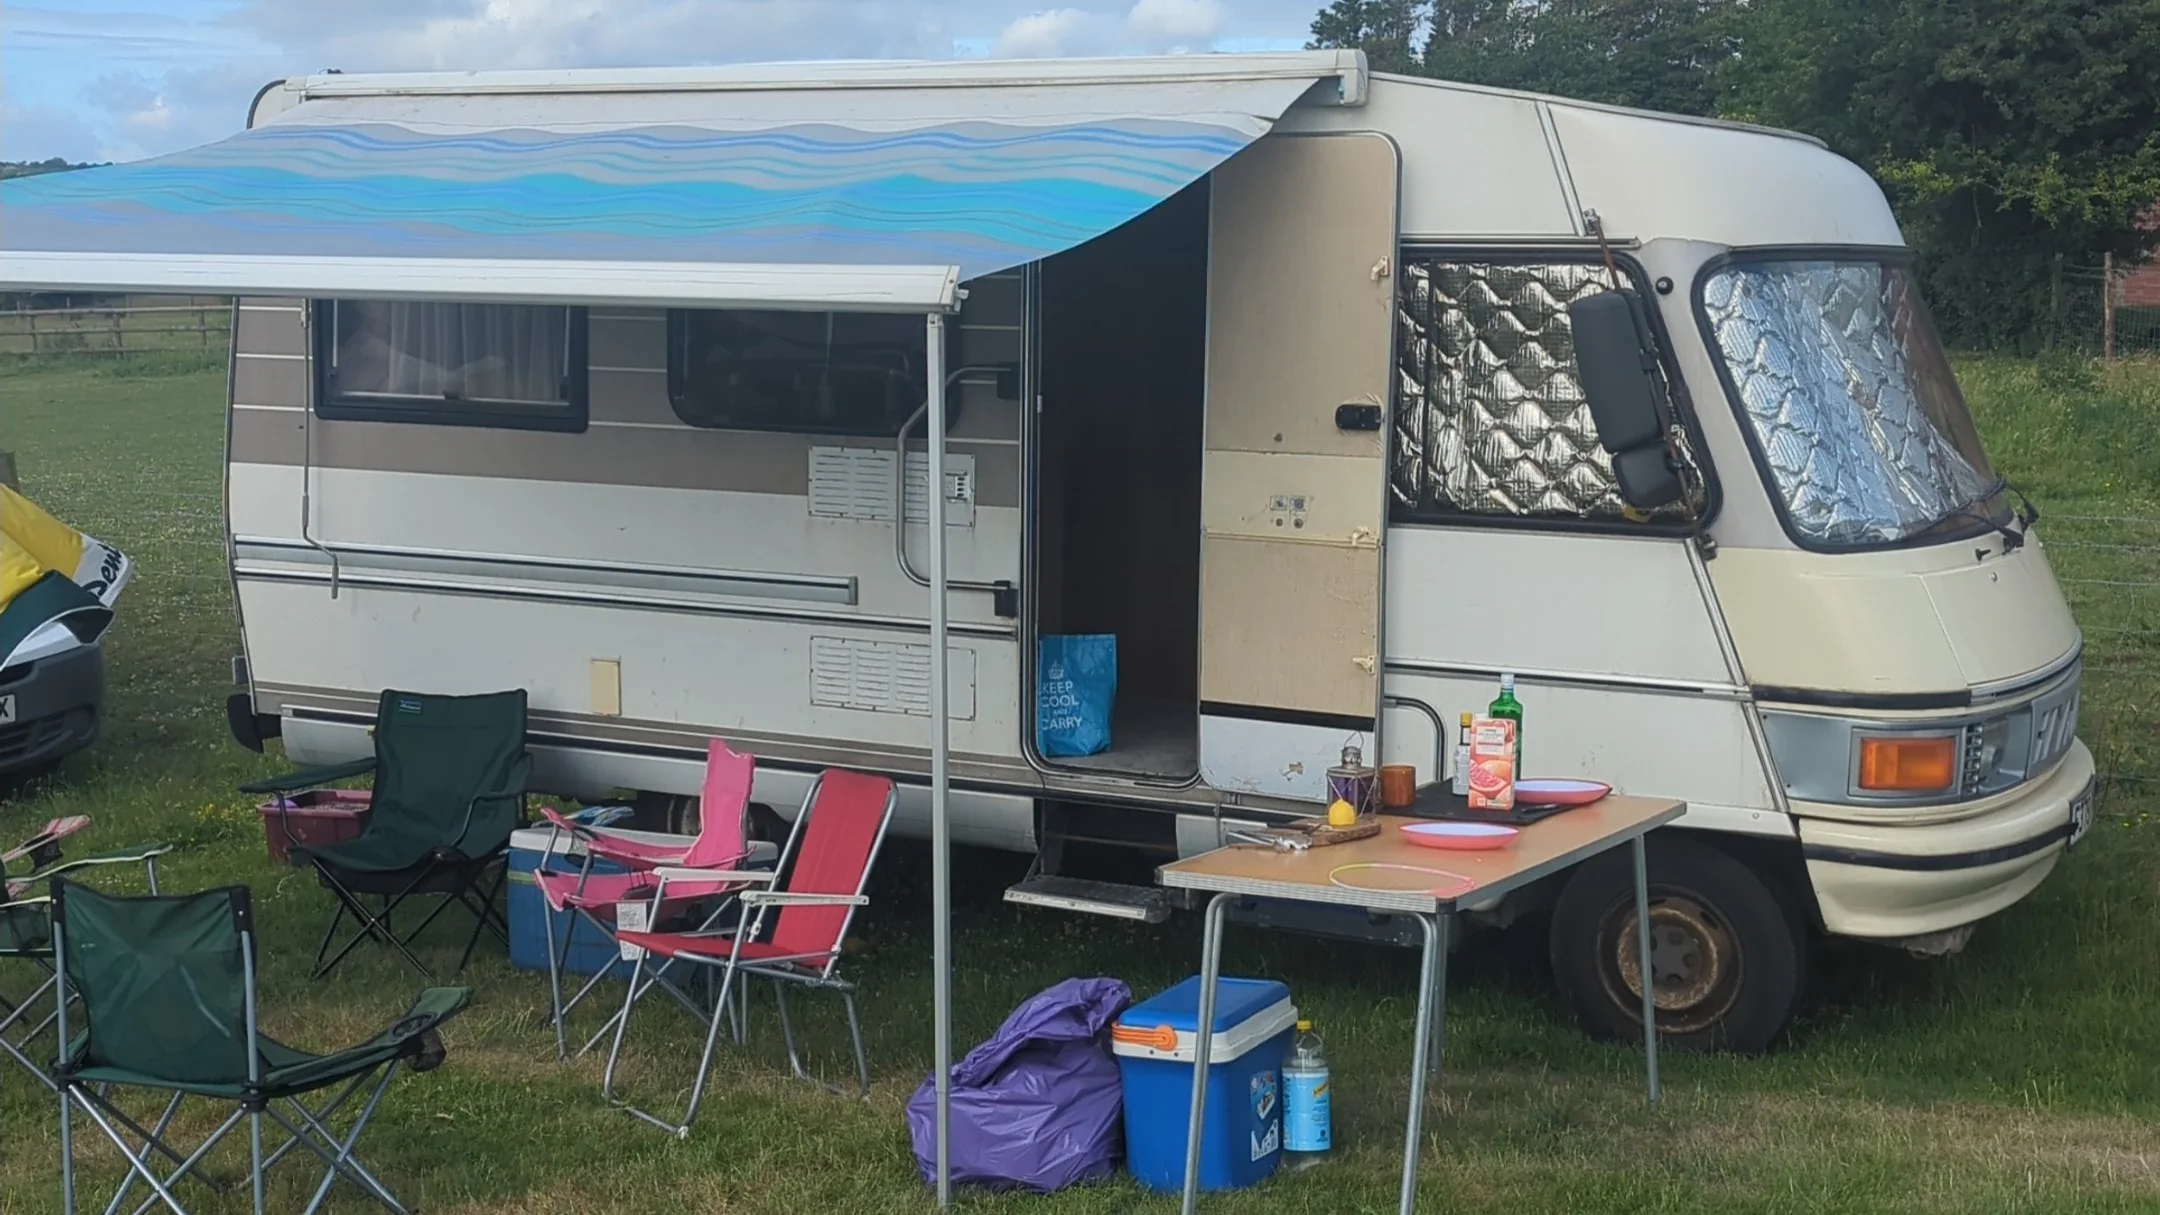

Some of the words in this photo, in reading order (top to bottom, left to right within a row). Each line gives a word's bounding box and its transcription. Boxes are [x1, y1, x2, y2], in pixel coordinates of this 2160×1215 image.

[1043, 680, 1073, 694] KEEP
[1040, 694, 1080, 707] COOL
[1042, 716, 1083, 730] CARRY
